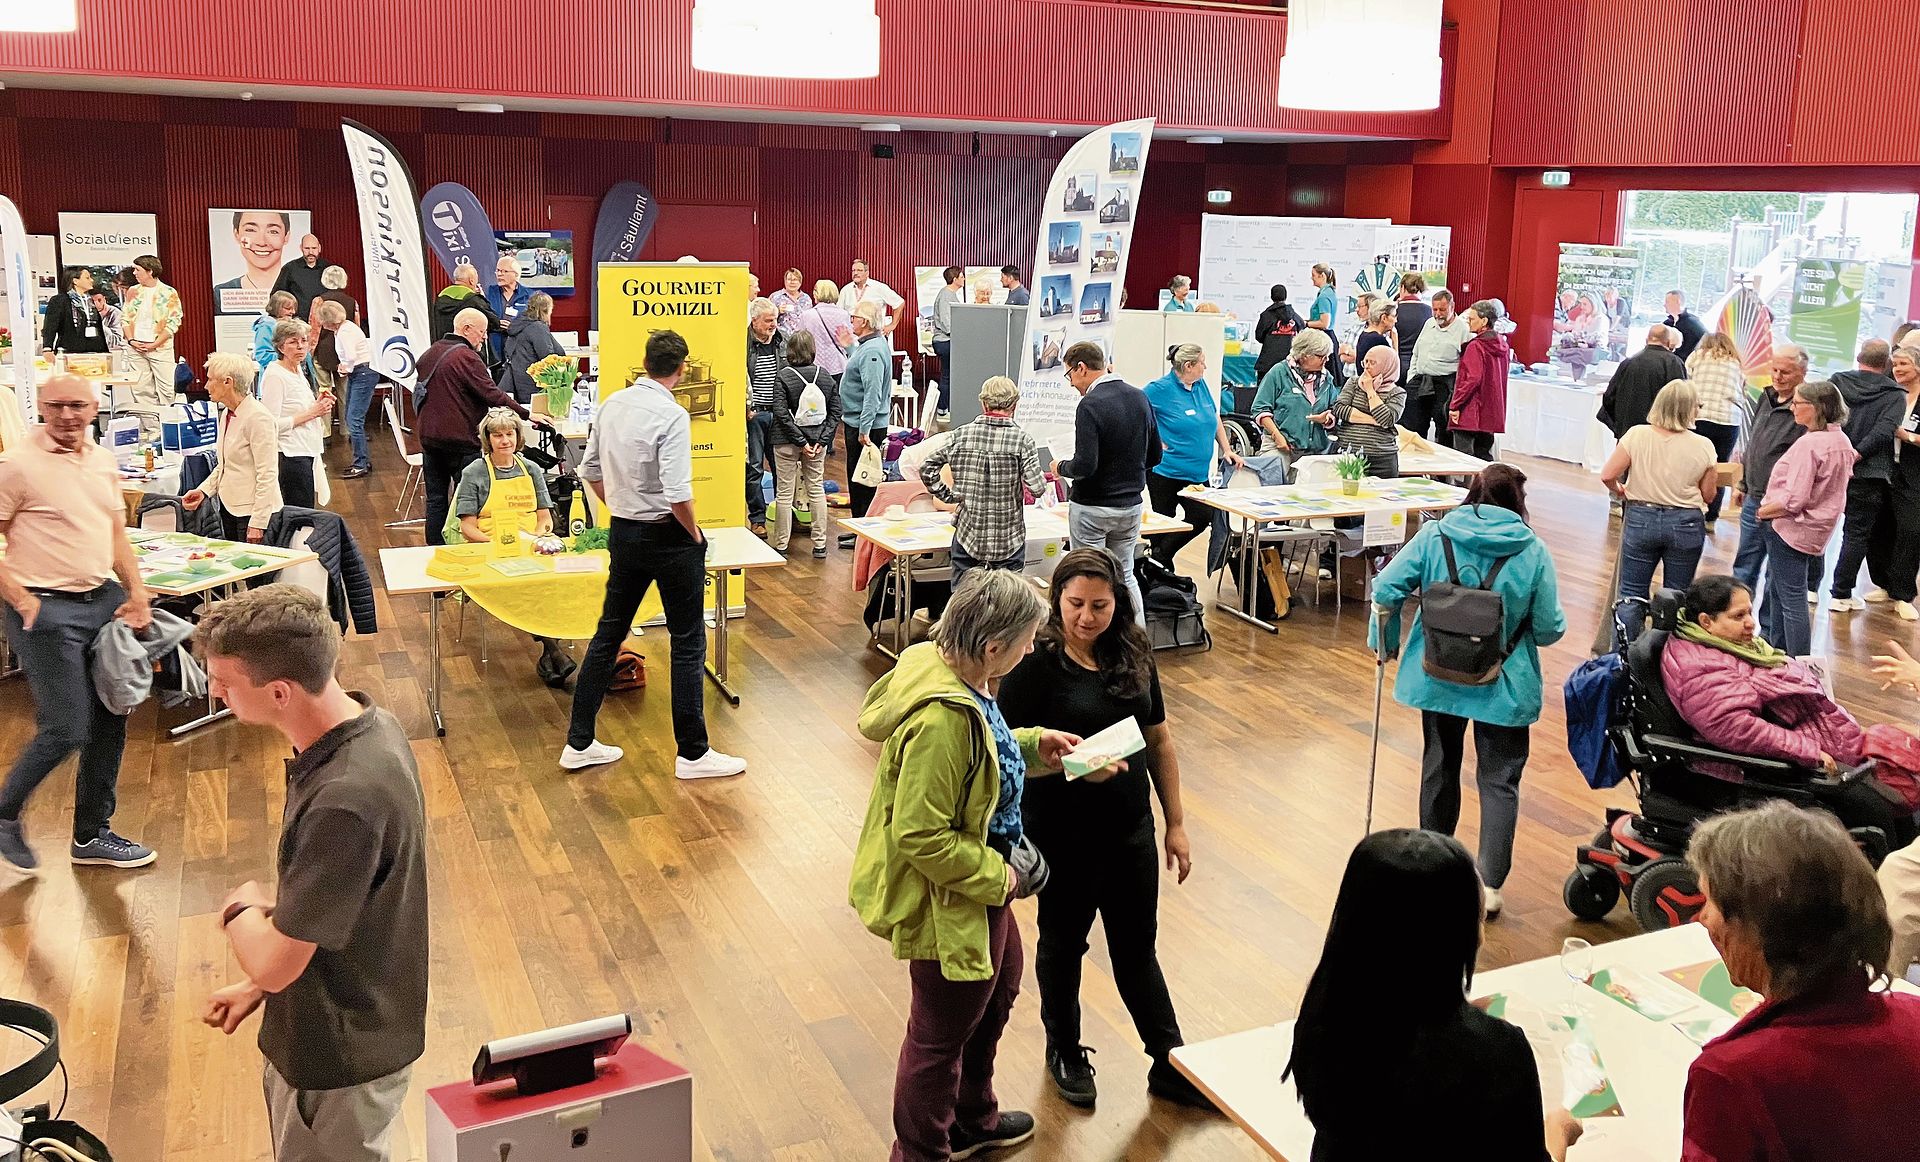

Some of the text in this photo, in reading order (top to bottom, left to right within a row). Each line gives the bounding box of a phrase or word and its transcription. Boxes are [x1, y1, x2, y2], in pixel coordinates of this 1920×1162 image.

[621, 193, 648, 253] Säuliamt
[65, 231, 152, 245] Sozialdienst
[622, 279, 726, 297] GOURMET
[632, 299, 719, 317] DOMIZIL
